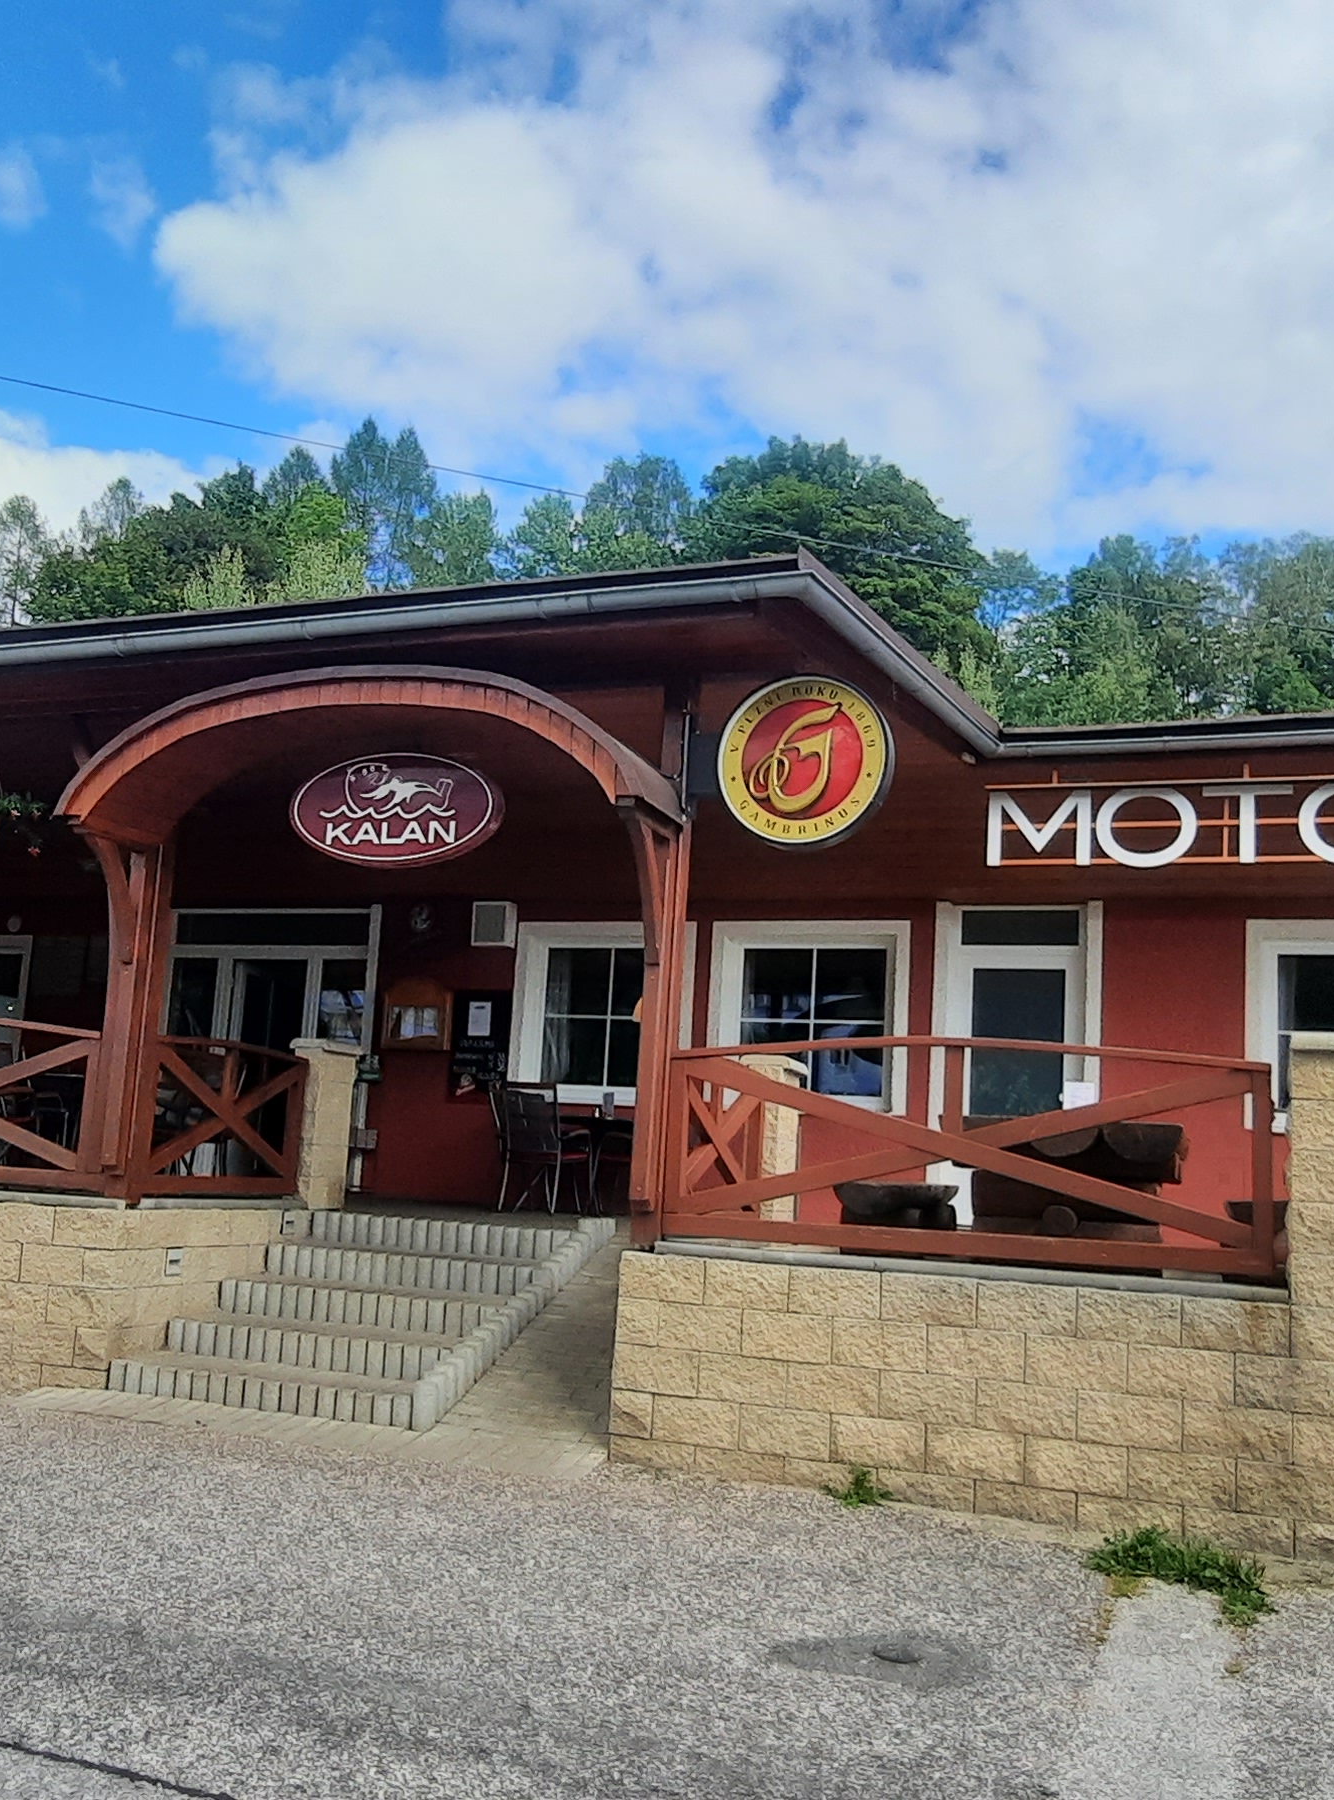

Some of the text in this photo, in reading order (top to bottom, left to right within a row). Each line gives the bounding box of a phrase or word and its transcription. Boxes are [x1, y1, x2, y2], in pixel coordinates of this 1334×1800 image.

[792, 686, 839, 699] ROKU
[848, 701, 876, 748] 1869
[325, 820, 457, 845] KALAN
[739, 797, 861, 835] GAMBRINUS
